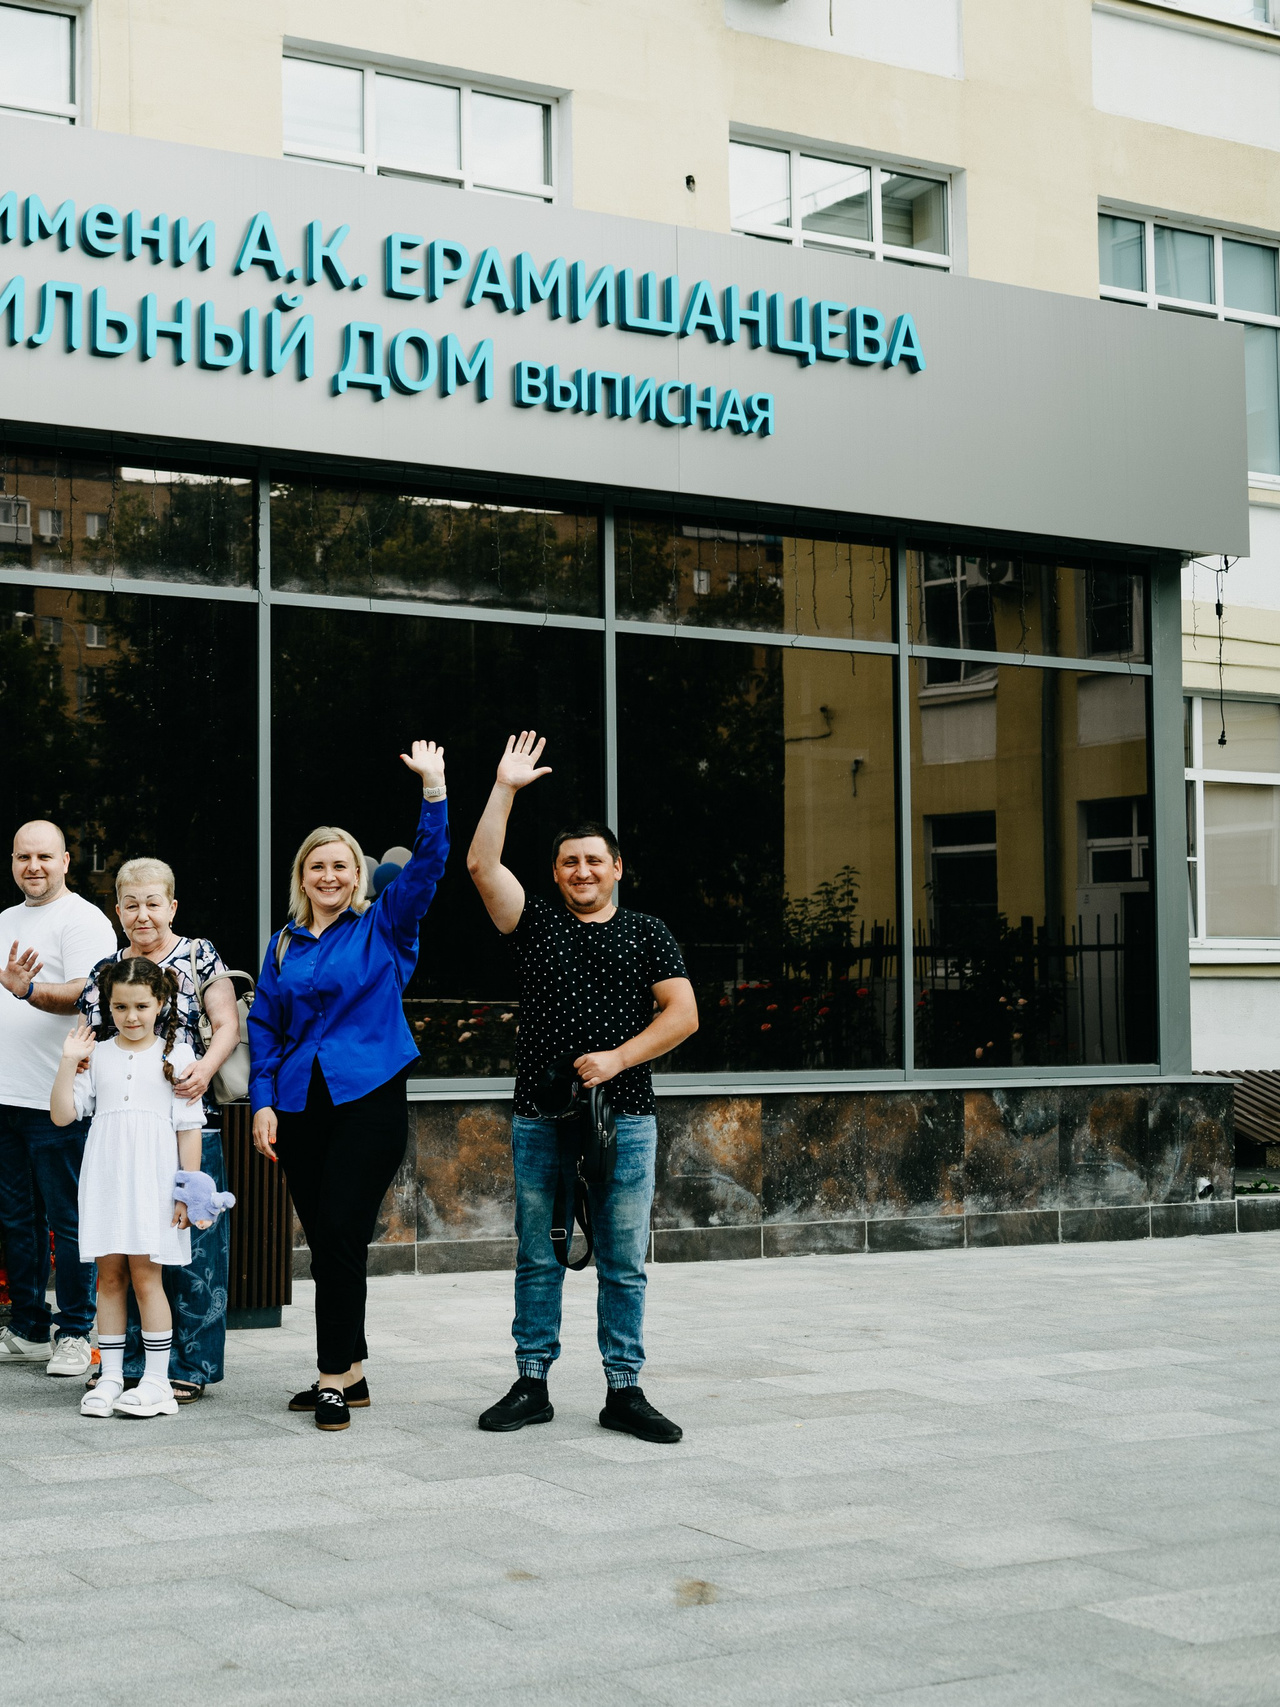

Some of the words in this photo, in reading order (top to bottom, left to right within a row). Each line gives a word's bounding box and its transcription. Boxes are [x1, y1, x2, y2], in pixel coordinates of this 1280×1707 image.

[232, 210, 369, 291] А.К.
[383, 231, 928, 373] ЕРАМИШАНЦЕВА
[330, 320, 495, 401] ДОМ
[513, 359, 776, 438] ВЫПИСНАЯ
